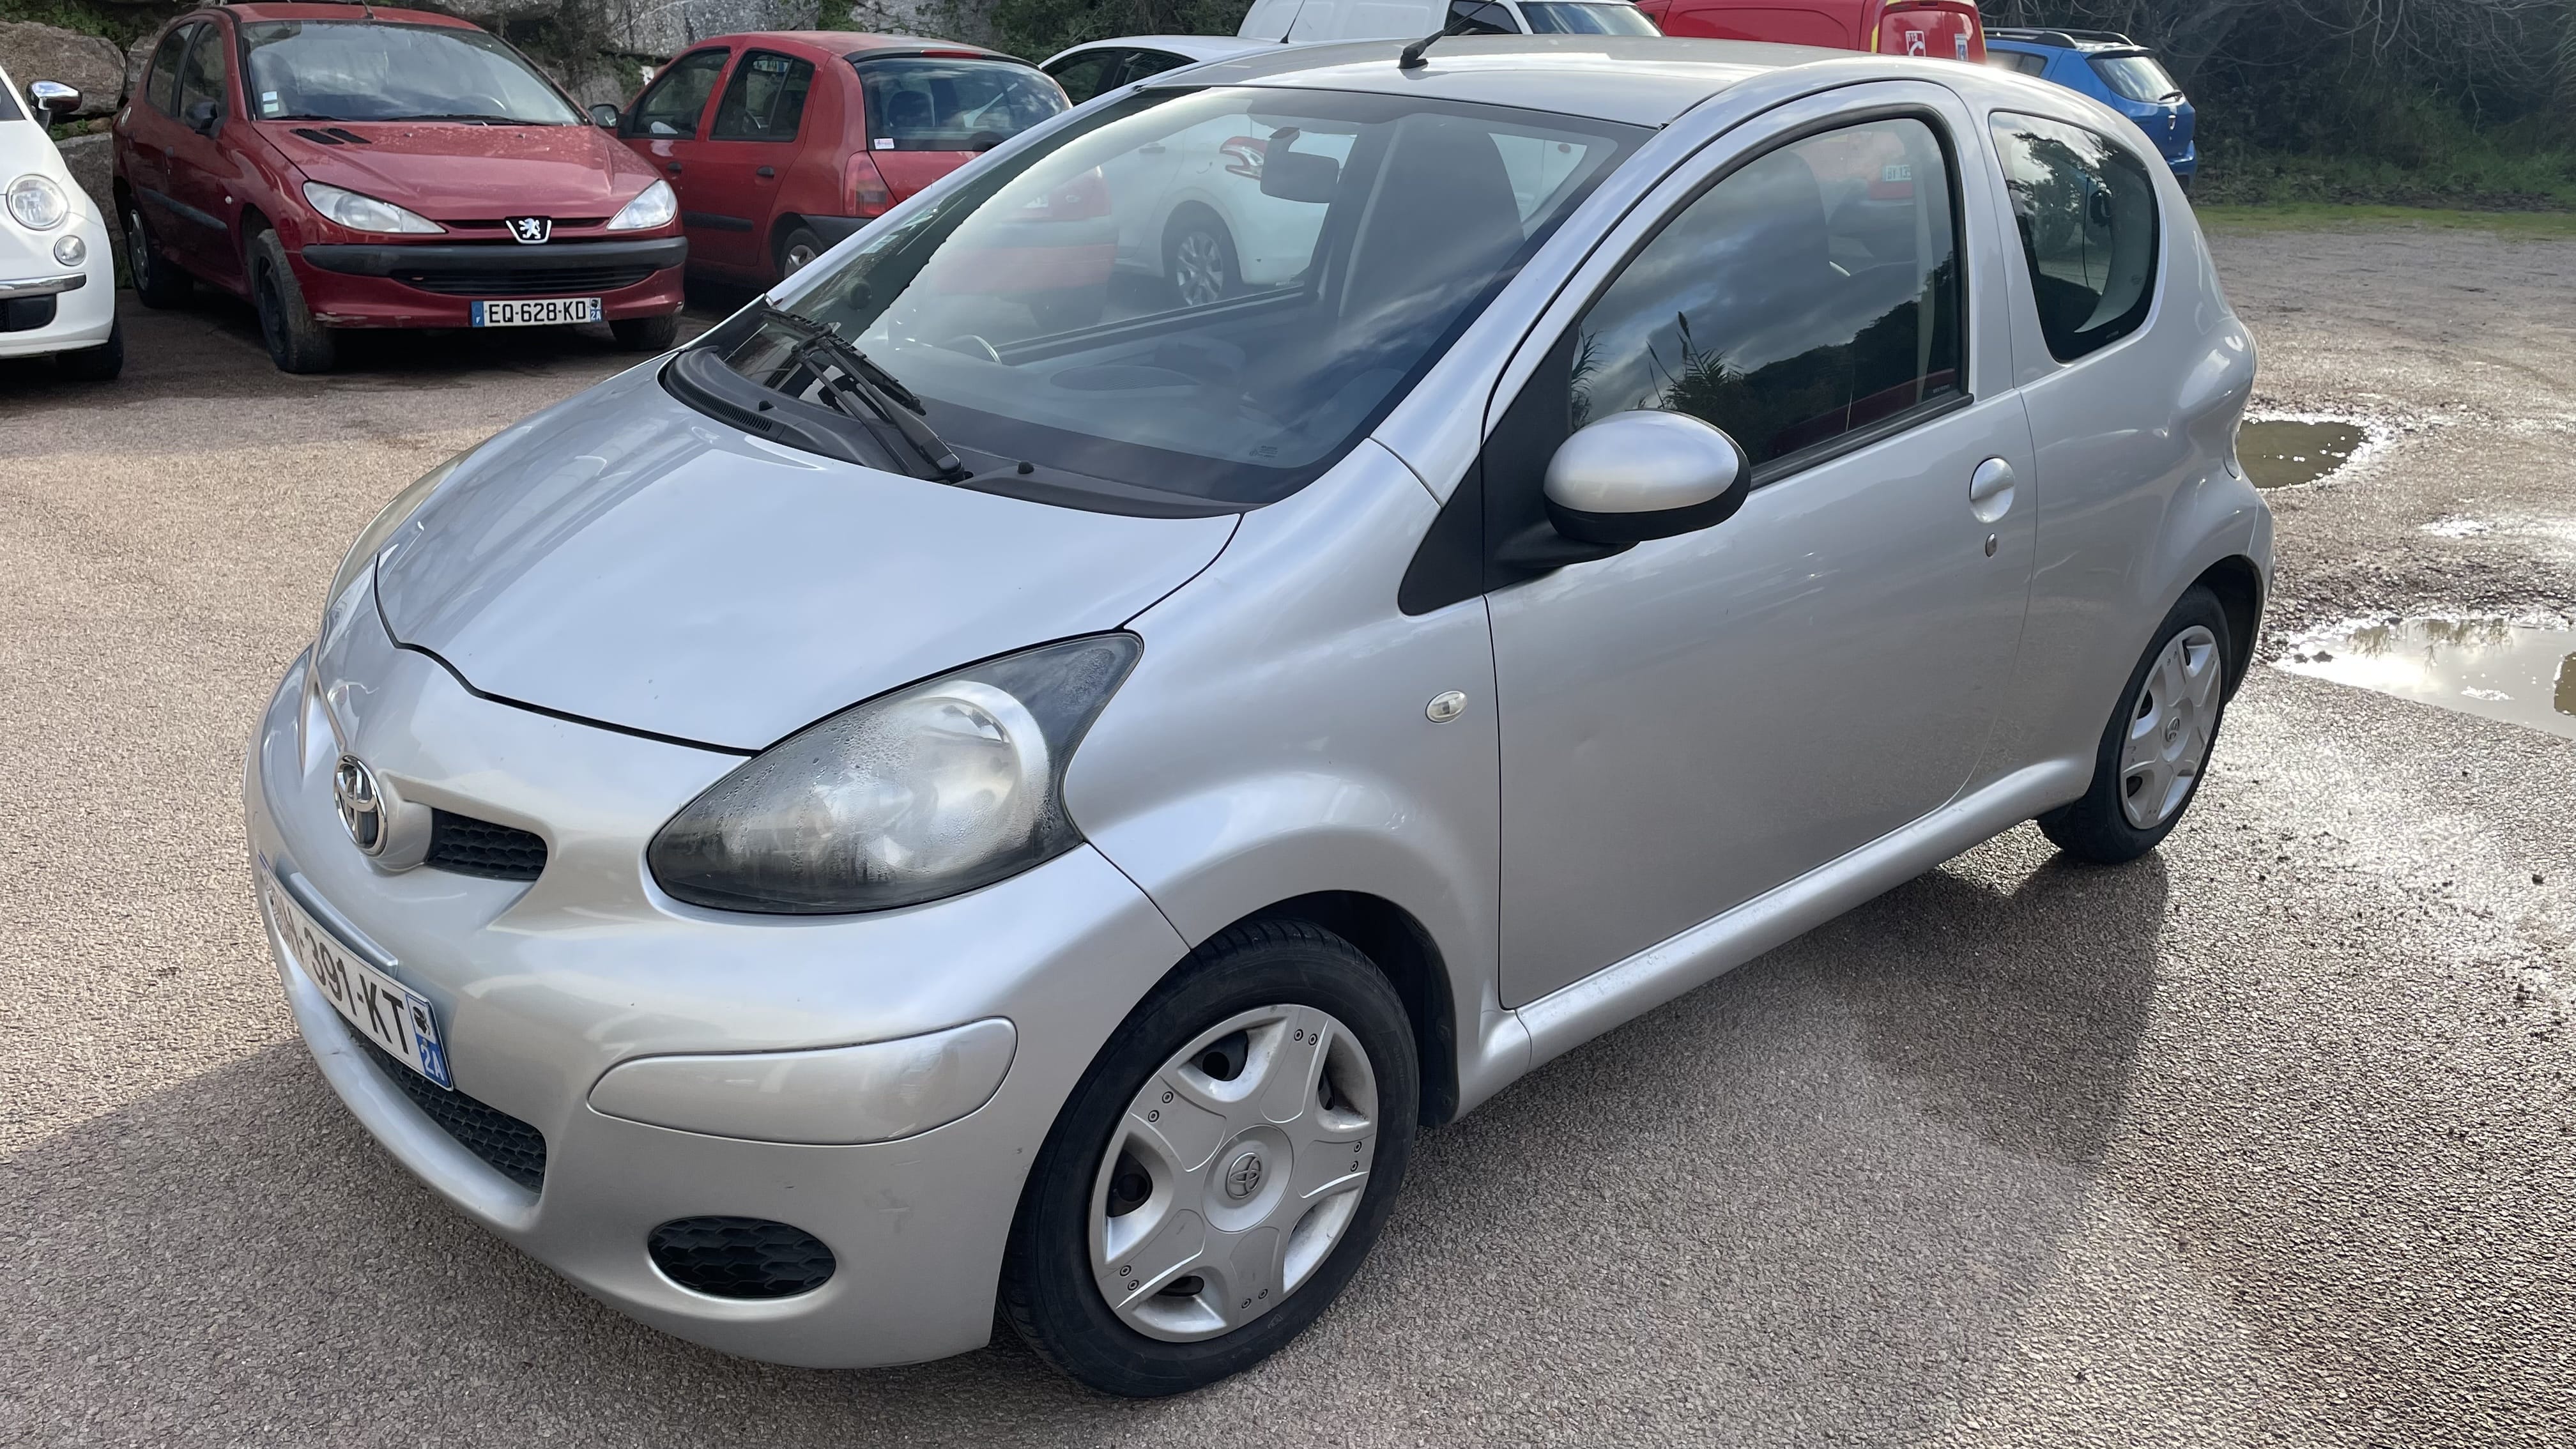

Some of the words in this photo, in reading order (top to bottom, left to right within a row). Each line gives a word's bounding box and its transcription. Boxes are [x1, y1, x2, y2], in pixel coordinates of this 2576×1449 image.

[1908, 33, 1918, 42] 112
[489, 301, 586, 323] EQ-628-KD
[590, 311, 601, 320] 2A
[421, 1046, 444, 1082] 2A
